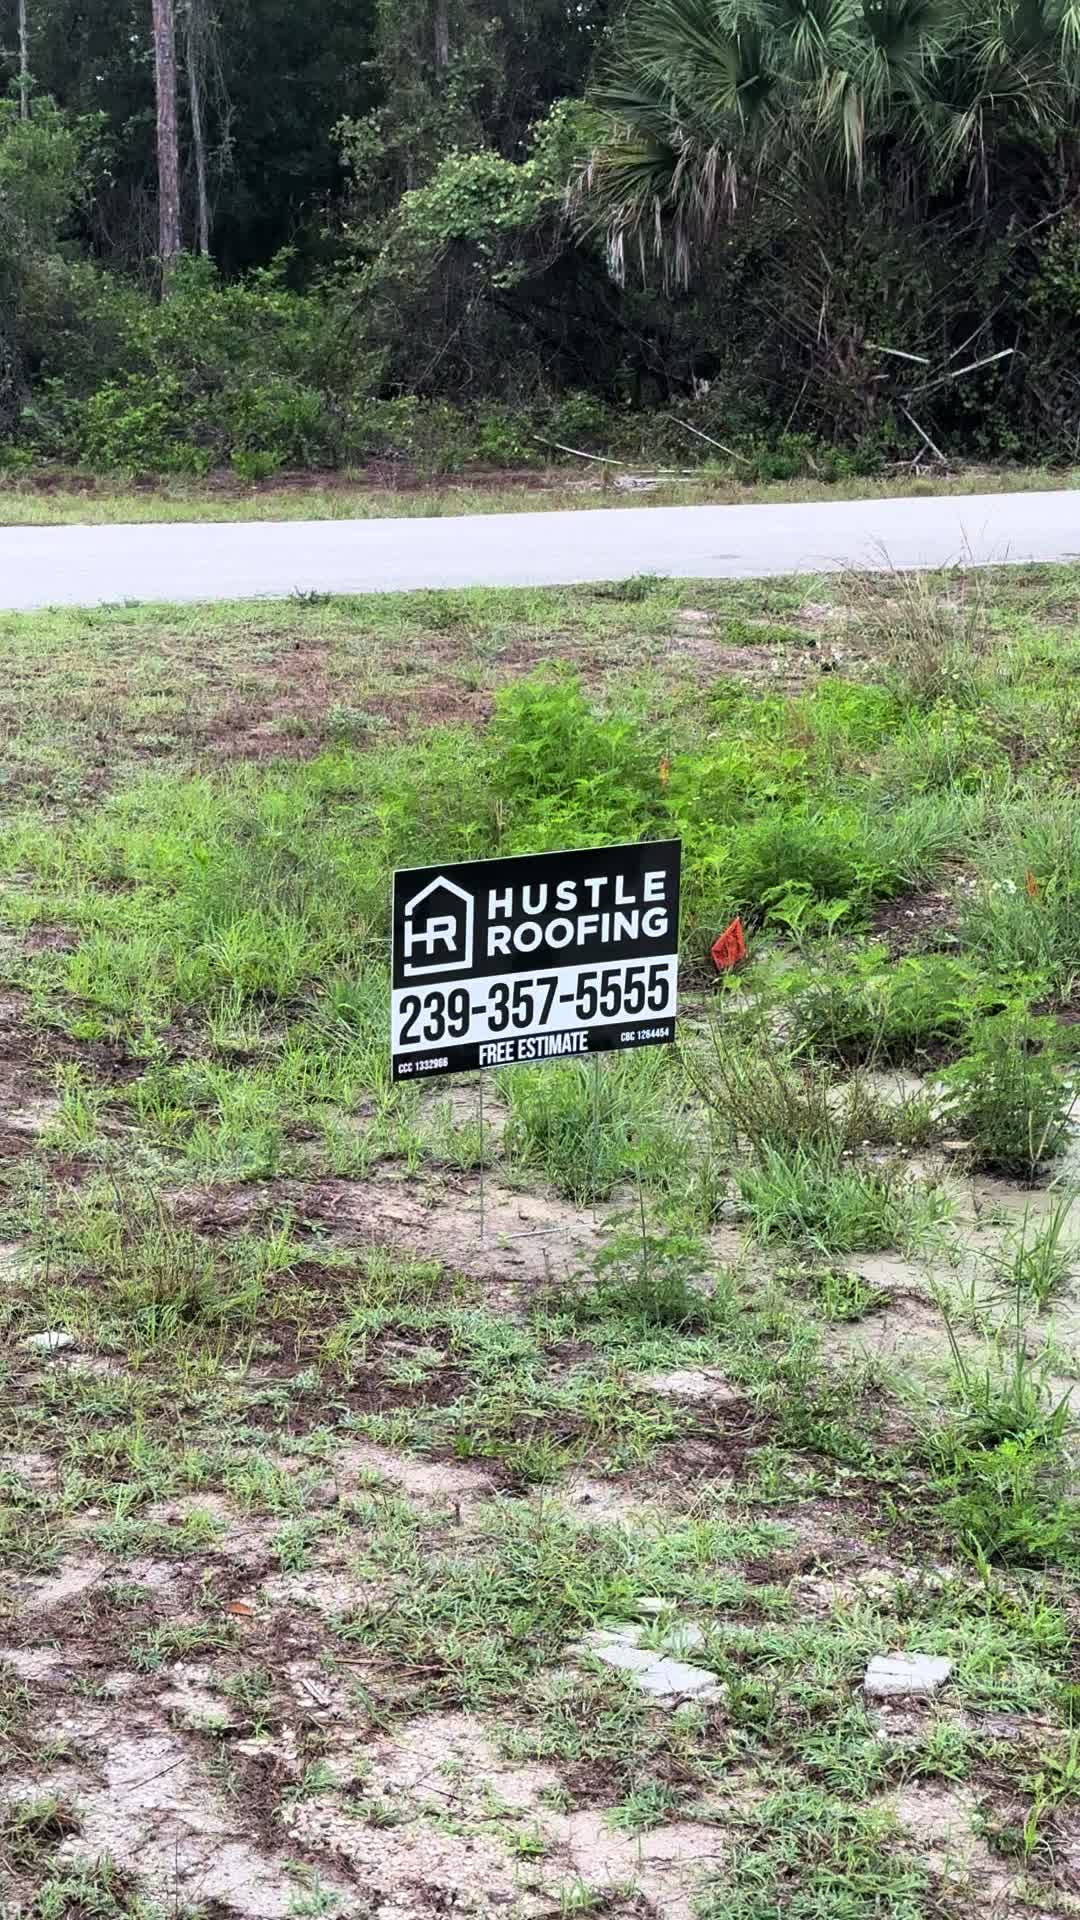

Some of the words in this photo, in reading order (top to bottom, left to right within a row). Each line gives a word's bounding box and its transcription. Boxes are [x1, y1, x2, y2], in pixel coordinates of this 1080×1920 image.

[488, 871, 666, 920] HUSTLE
[487, 907, 669, 957] ROOFING
[399, 964, 669, 1046] 239-357-5555
[479, 1040, 515, 1066] FREE
[518, 1031, 589, 1059] ESTIMATE
[620, 1031, 635, 1042] CBC
[398, 1062, 413, 1074] CCC
